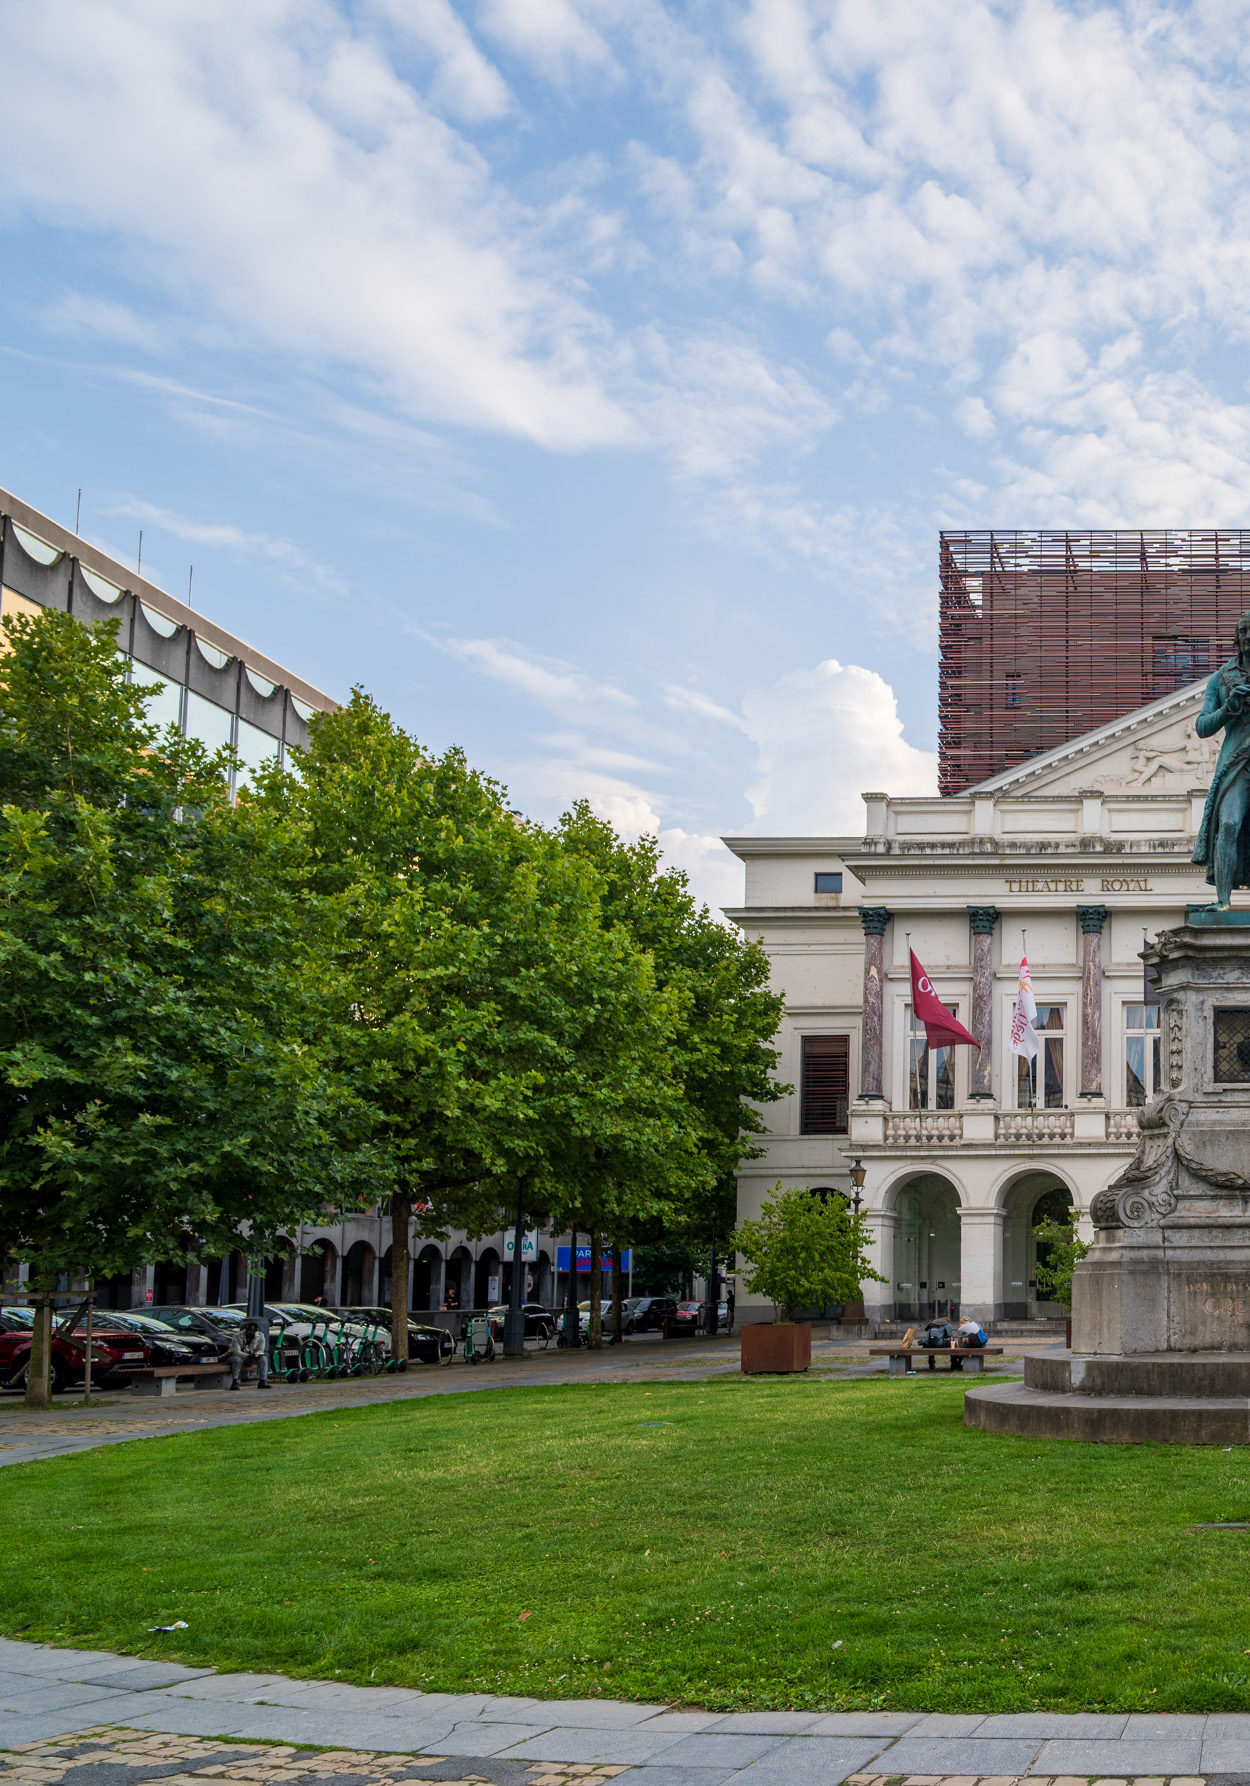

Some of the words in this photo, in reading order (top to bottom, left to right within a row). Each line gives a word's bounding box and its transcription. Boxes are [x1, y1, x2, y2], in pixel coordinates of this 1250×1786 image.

[1005, 879, 1084, 893] THEATRE
[1100, 879, 1153, 892] ROYAL
[506, 1241, 534, 1251] ORA
[575, 1258, 613, 1267] OPRA
